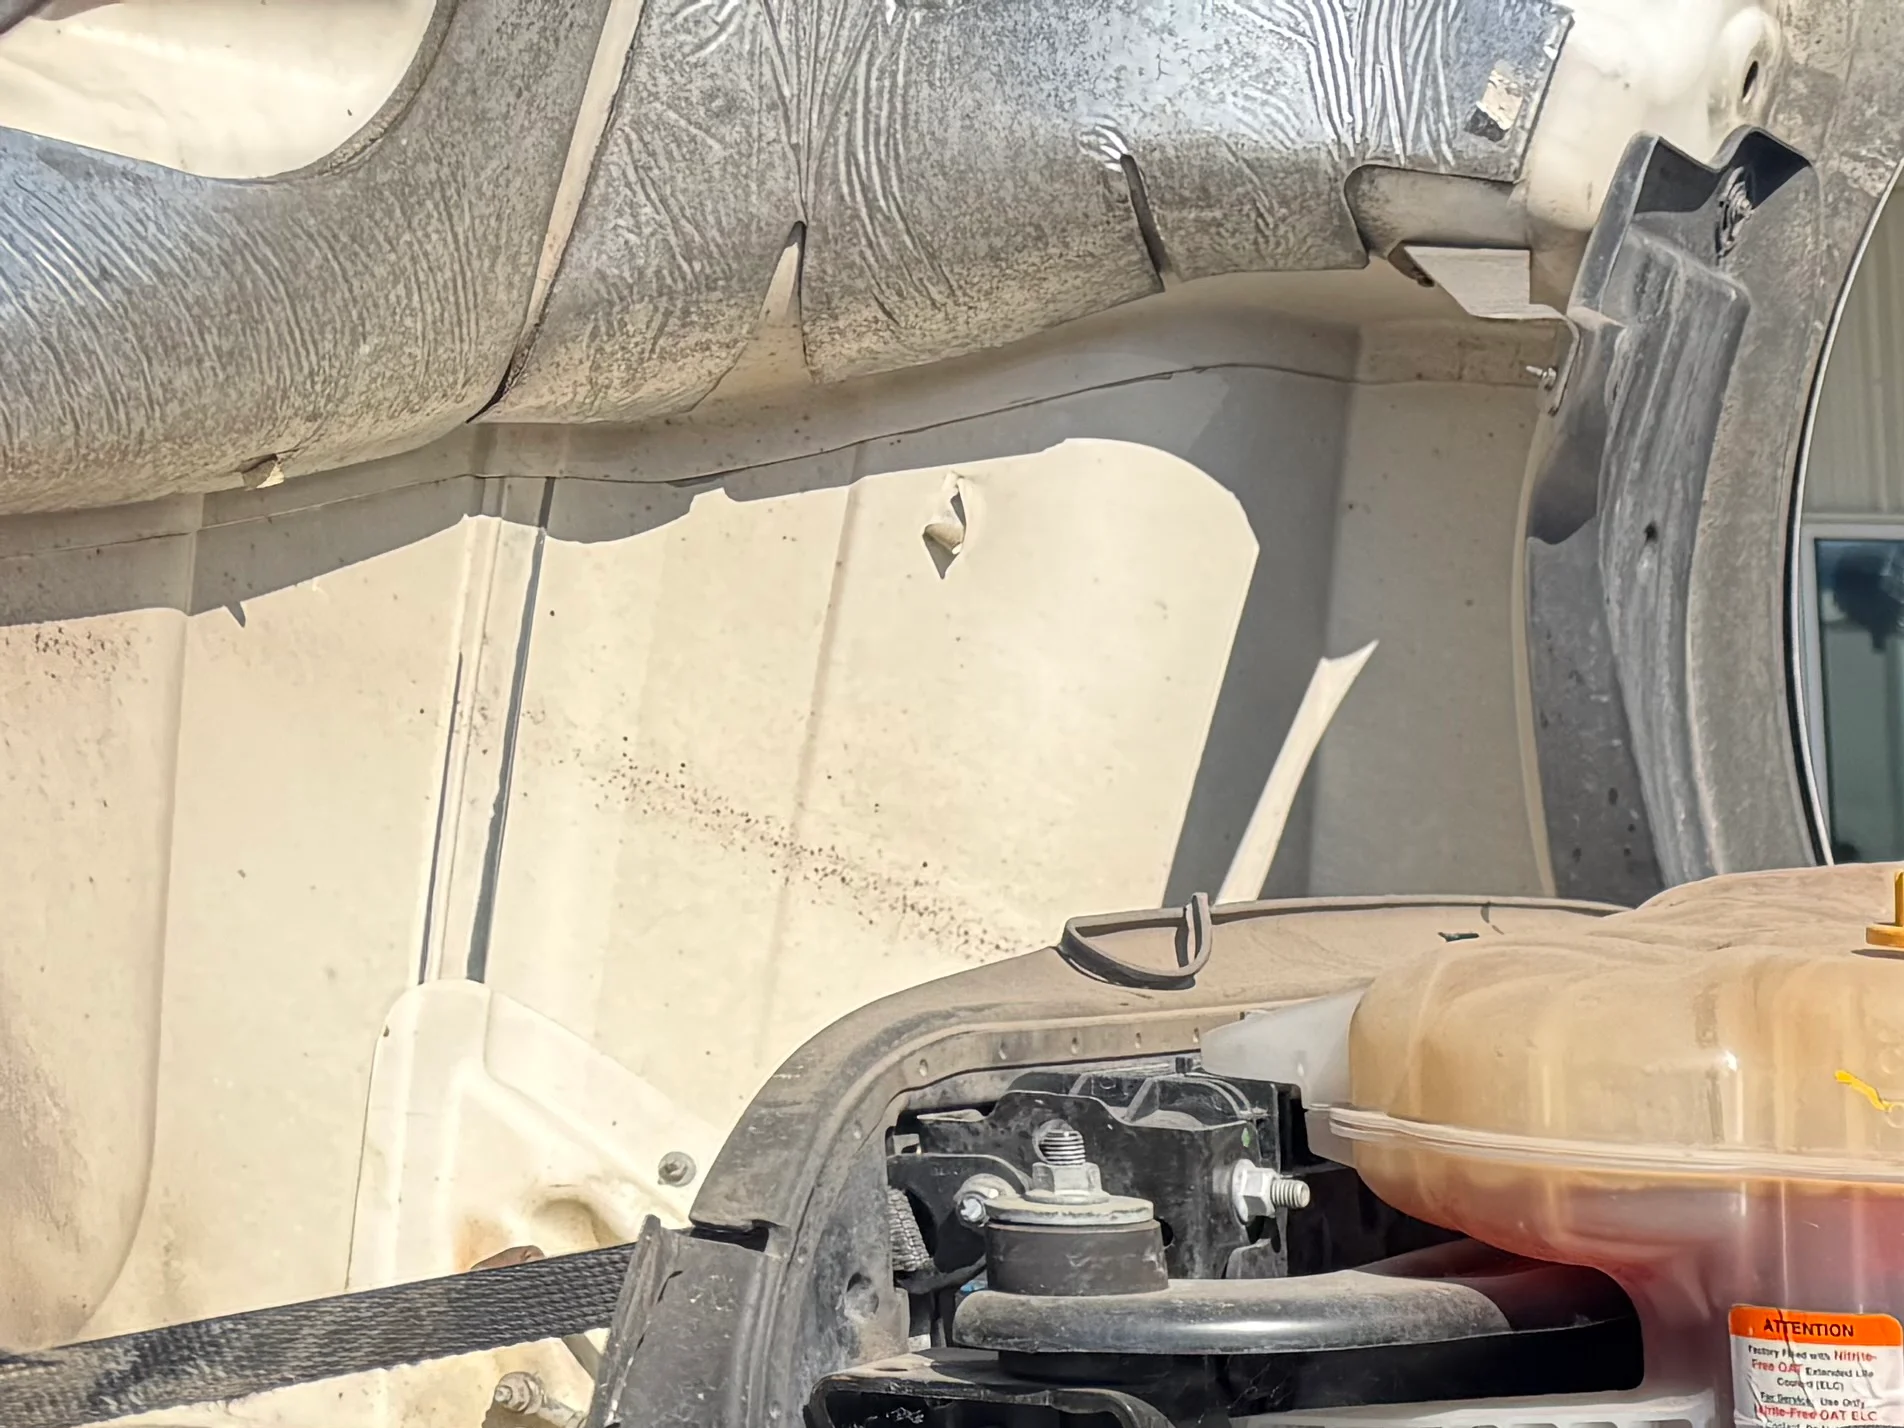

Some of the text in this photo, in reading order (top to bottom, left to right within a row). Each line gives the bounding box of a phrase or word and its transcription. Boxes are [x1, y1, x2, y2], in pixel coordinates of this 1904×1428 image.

[1764, 1317, 1854, 1338] ATTENTION
[1751, 1358, 1775, 1372] Free
[1778, 1361, 1803, 1375] OAT
[1820, 1410, 1847, 1421] OAT
[1852, 1411, 1877, 1421] ELC
